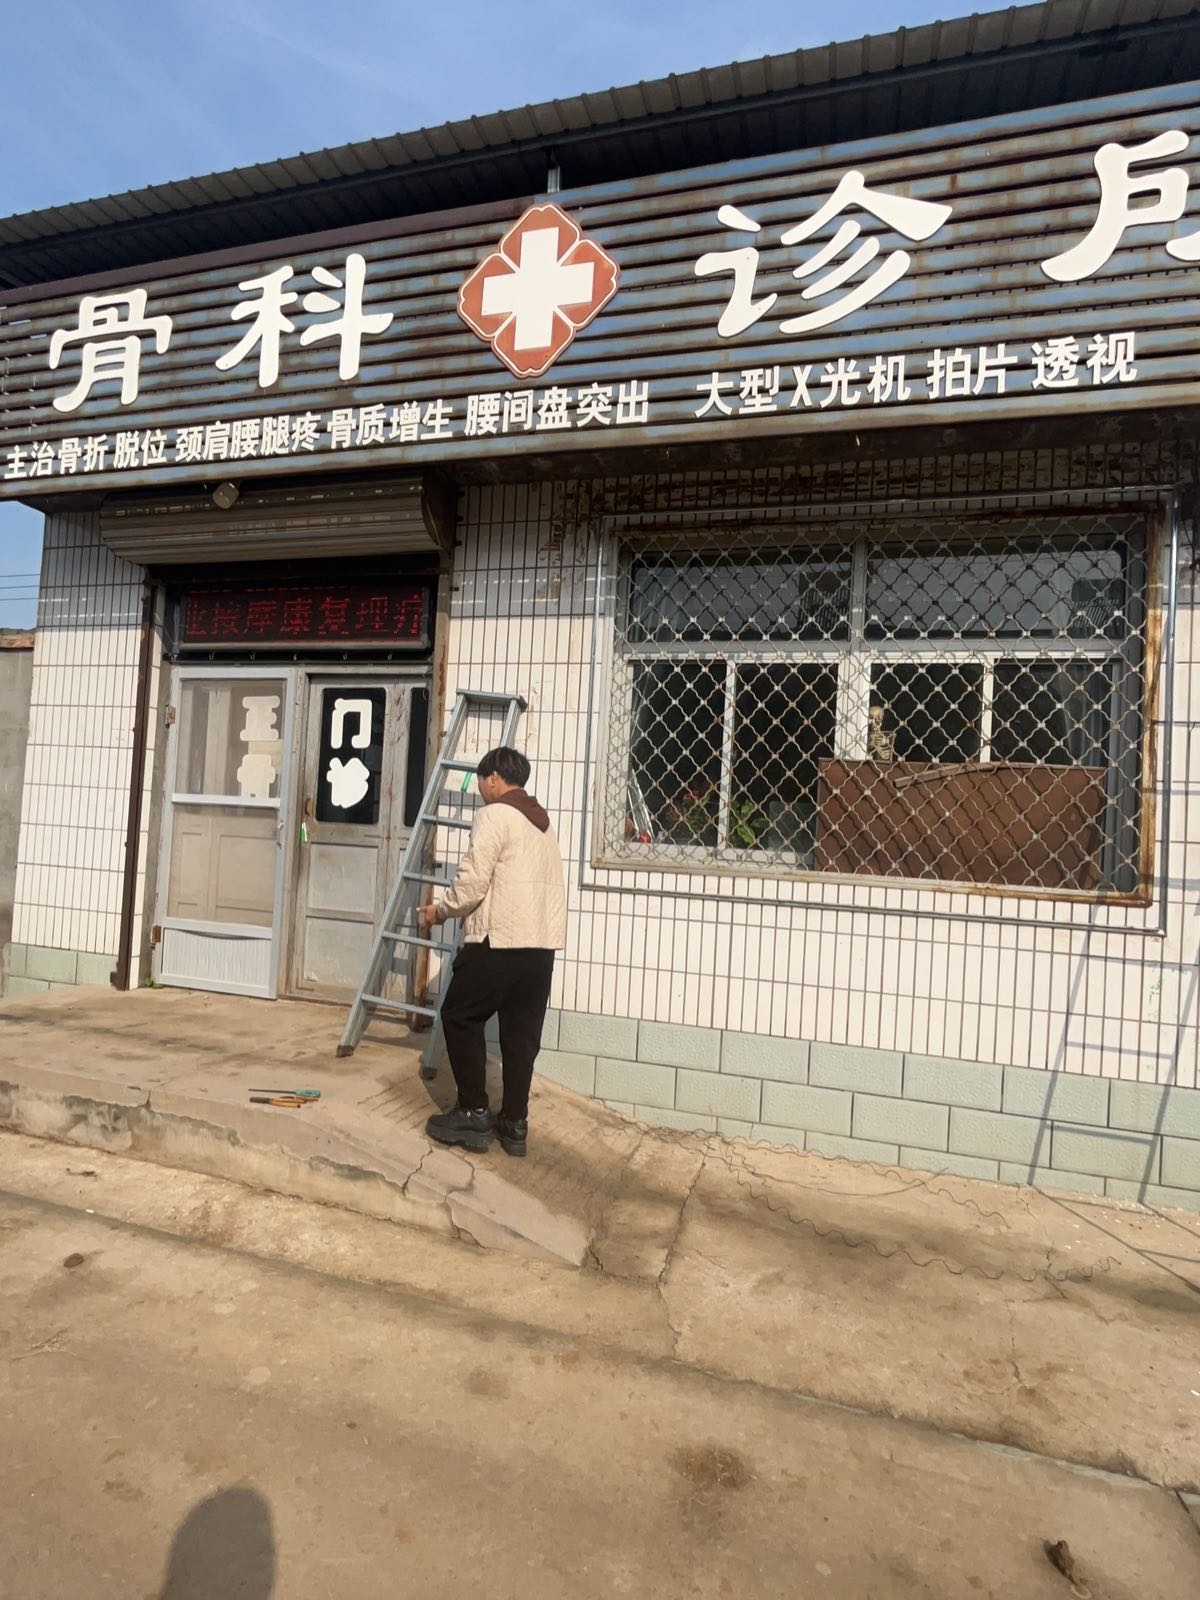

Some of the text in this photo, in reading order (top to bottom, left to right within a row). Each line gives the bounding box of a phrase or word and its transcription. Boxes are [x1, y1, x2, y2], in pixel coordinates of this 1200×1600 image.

[4, 435, 108, 478] 主治骨折
[113, 430, 167, 468] 脱位
[175, 412, 321, 462] 颈肩腰腿疼
[327, 399, 453, 448] 骨质增生
[464, 379, 648, 435] 腰间盘突出
[927, 344, 1018, 399] 拍片
[1032, 332, 1138, 388] 透视
[49, 253, 395, 413] 骨科
